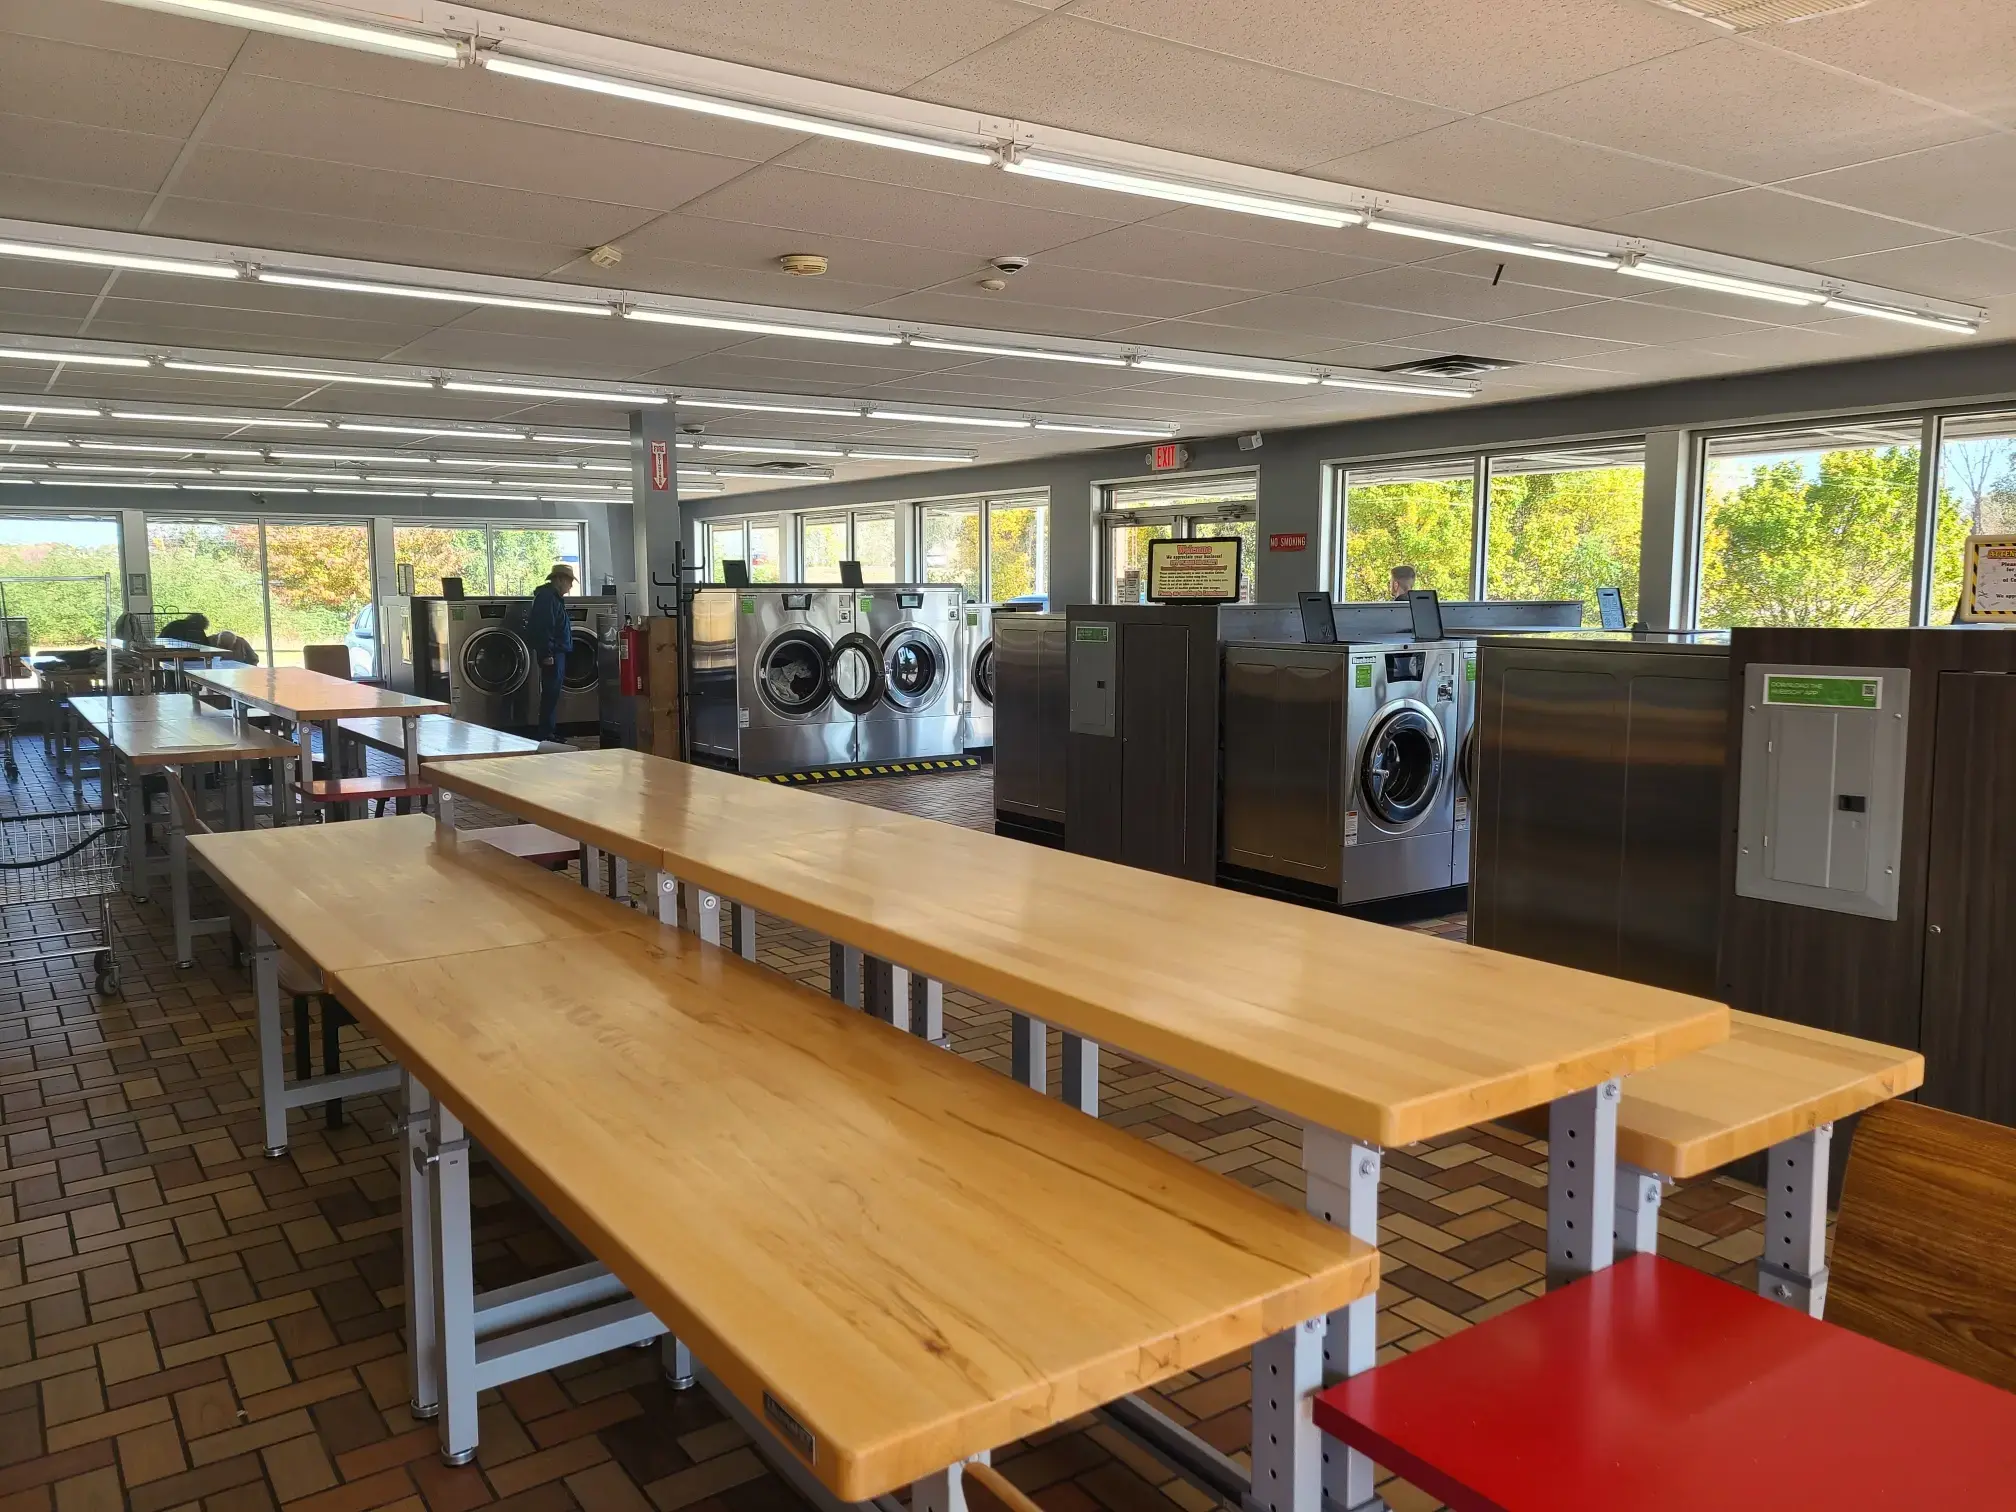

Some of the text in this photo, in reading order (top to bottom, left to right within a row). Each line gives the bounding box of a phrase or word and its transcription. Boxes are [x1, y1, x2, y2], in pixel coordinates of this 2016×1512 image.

[1156, 445, 1176, 468] EXIT
[1270, 536, 1306, 547] NO SMOKING
